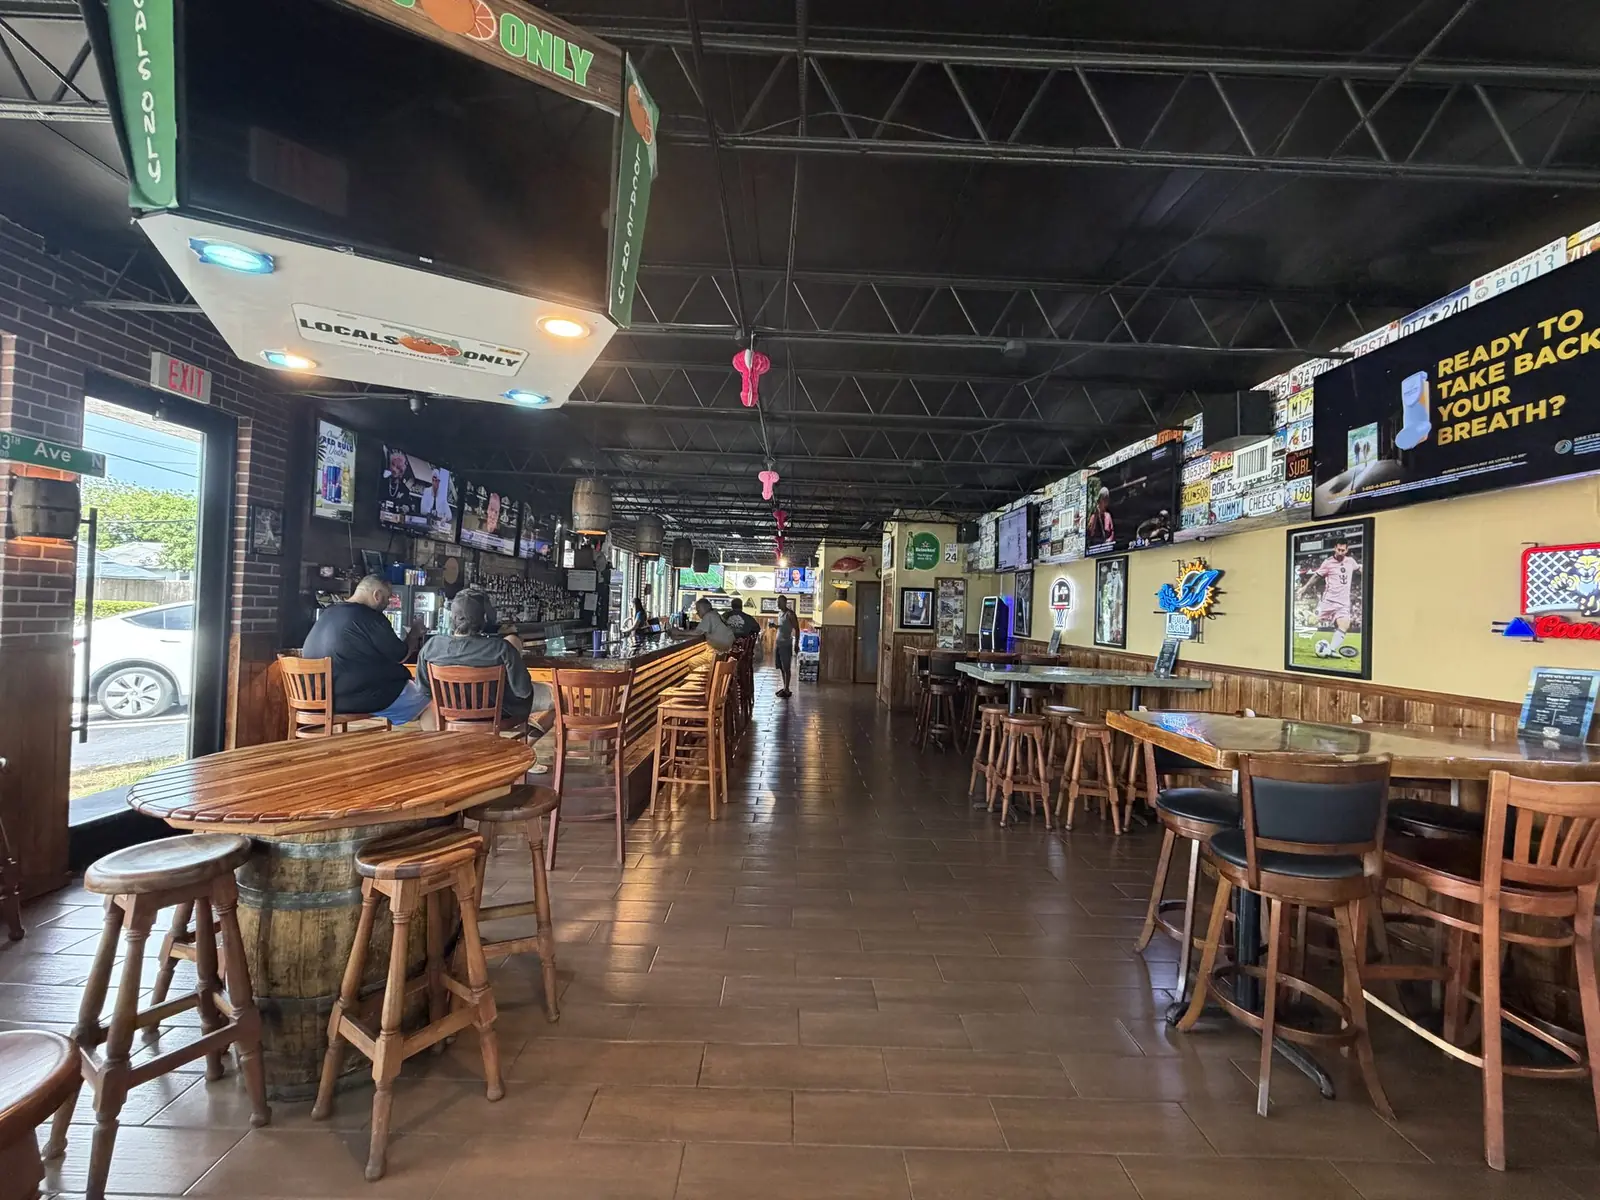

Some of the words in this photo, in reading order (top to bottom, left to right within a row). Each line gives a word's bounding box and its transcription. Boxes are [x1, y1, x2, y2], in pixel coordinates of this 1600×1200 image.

[500, 12, 594, 87] ONLY
[141, 91, 161, 184] ONLY
[626, 142, 641, 237] LOCALS
[618, 241, 630, 304] ONLY
[299, 318, 399, 346] LOCALS
[463, 350, 520, 367] ONLY
[359, 342, 447, 363] NEIGHBORHOOD
[1438, 327, 1531, 378] READY
[1537, 309, 1584, 339] TO
[168, 359, 204, 397] EXIT
[1437, 362, 1506, 399] TAKE
[1514, 331, 1600, 376] BACK
[1437, 394, 1566, 446] BREATH?
[1438, 385, 1511, 422] YOUR
[34, 442, 72, 462] Ave
[91, 454, 104, 469] N
[322, 436, 336, 446] RED
[337, 441, 353, 452] BULL
[1217, 500, 1240, 517] YUMMY
[1249, 492, 1277, 511] CHEESE
[946, 553, 957, 562] 24
